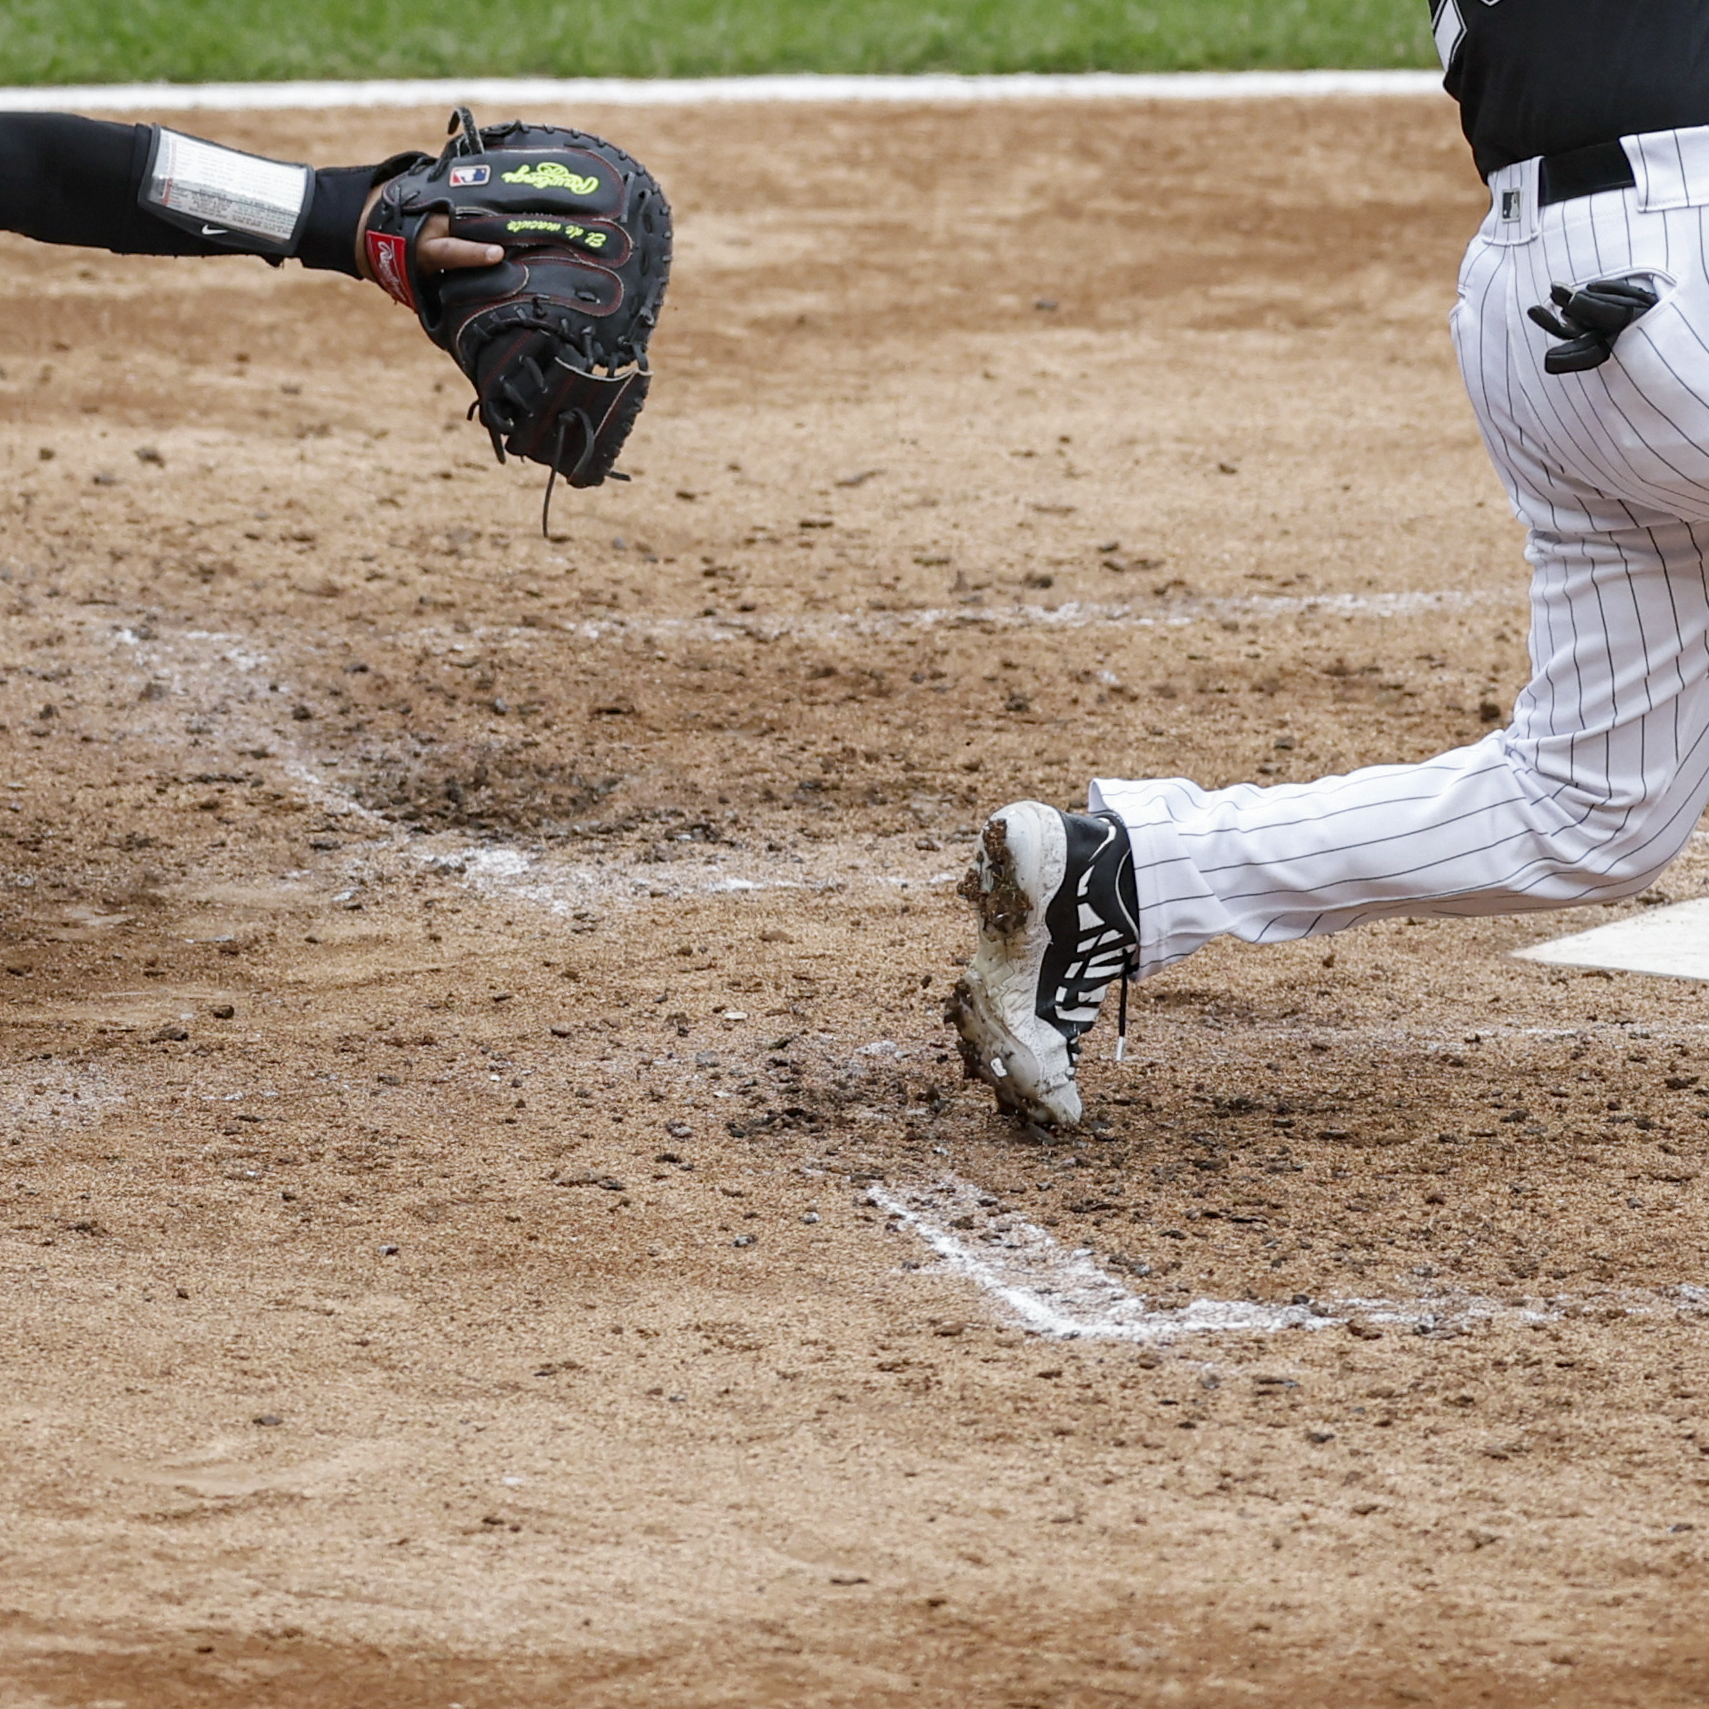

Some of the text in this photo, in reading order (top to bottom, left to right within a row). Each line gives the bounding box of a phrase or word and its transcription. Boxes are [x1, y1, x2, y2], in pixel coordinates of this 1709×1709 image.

[501, 164, 600, 195] Rawlings
[565, 225, 584, 239] de
[585, 232, 607, 248] El
